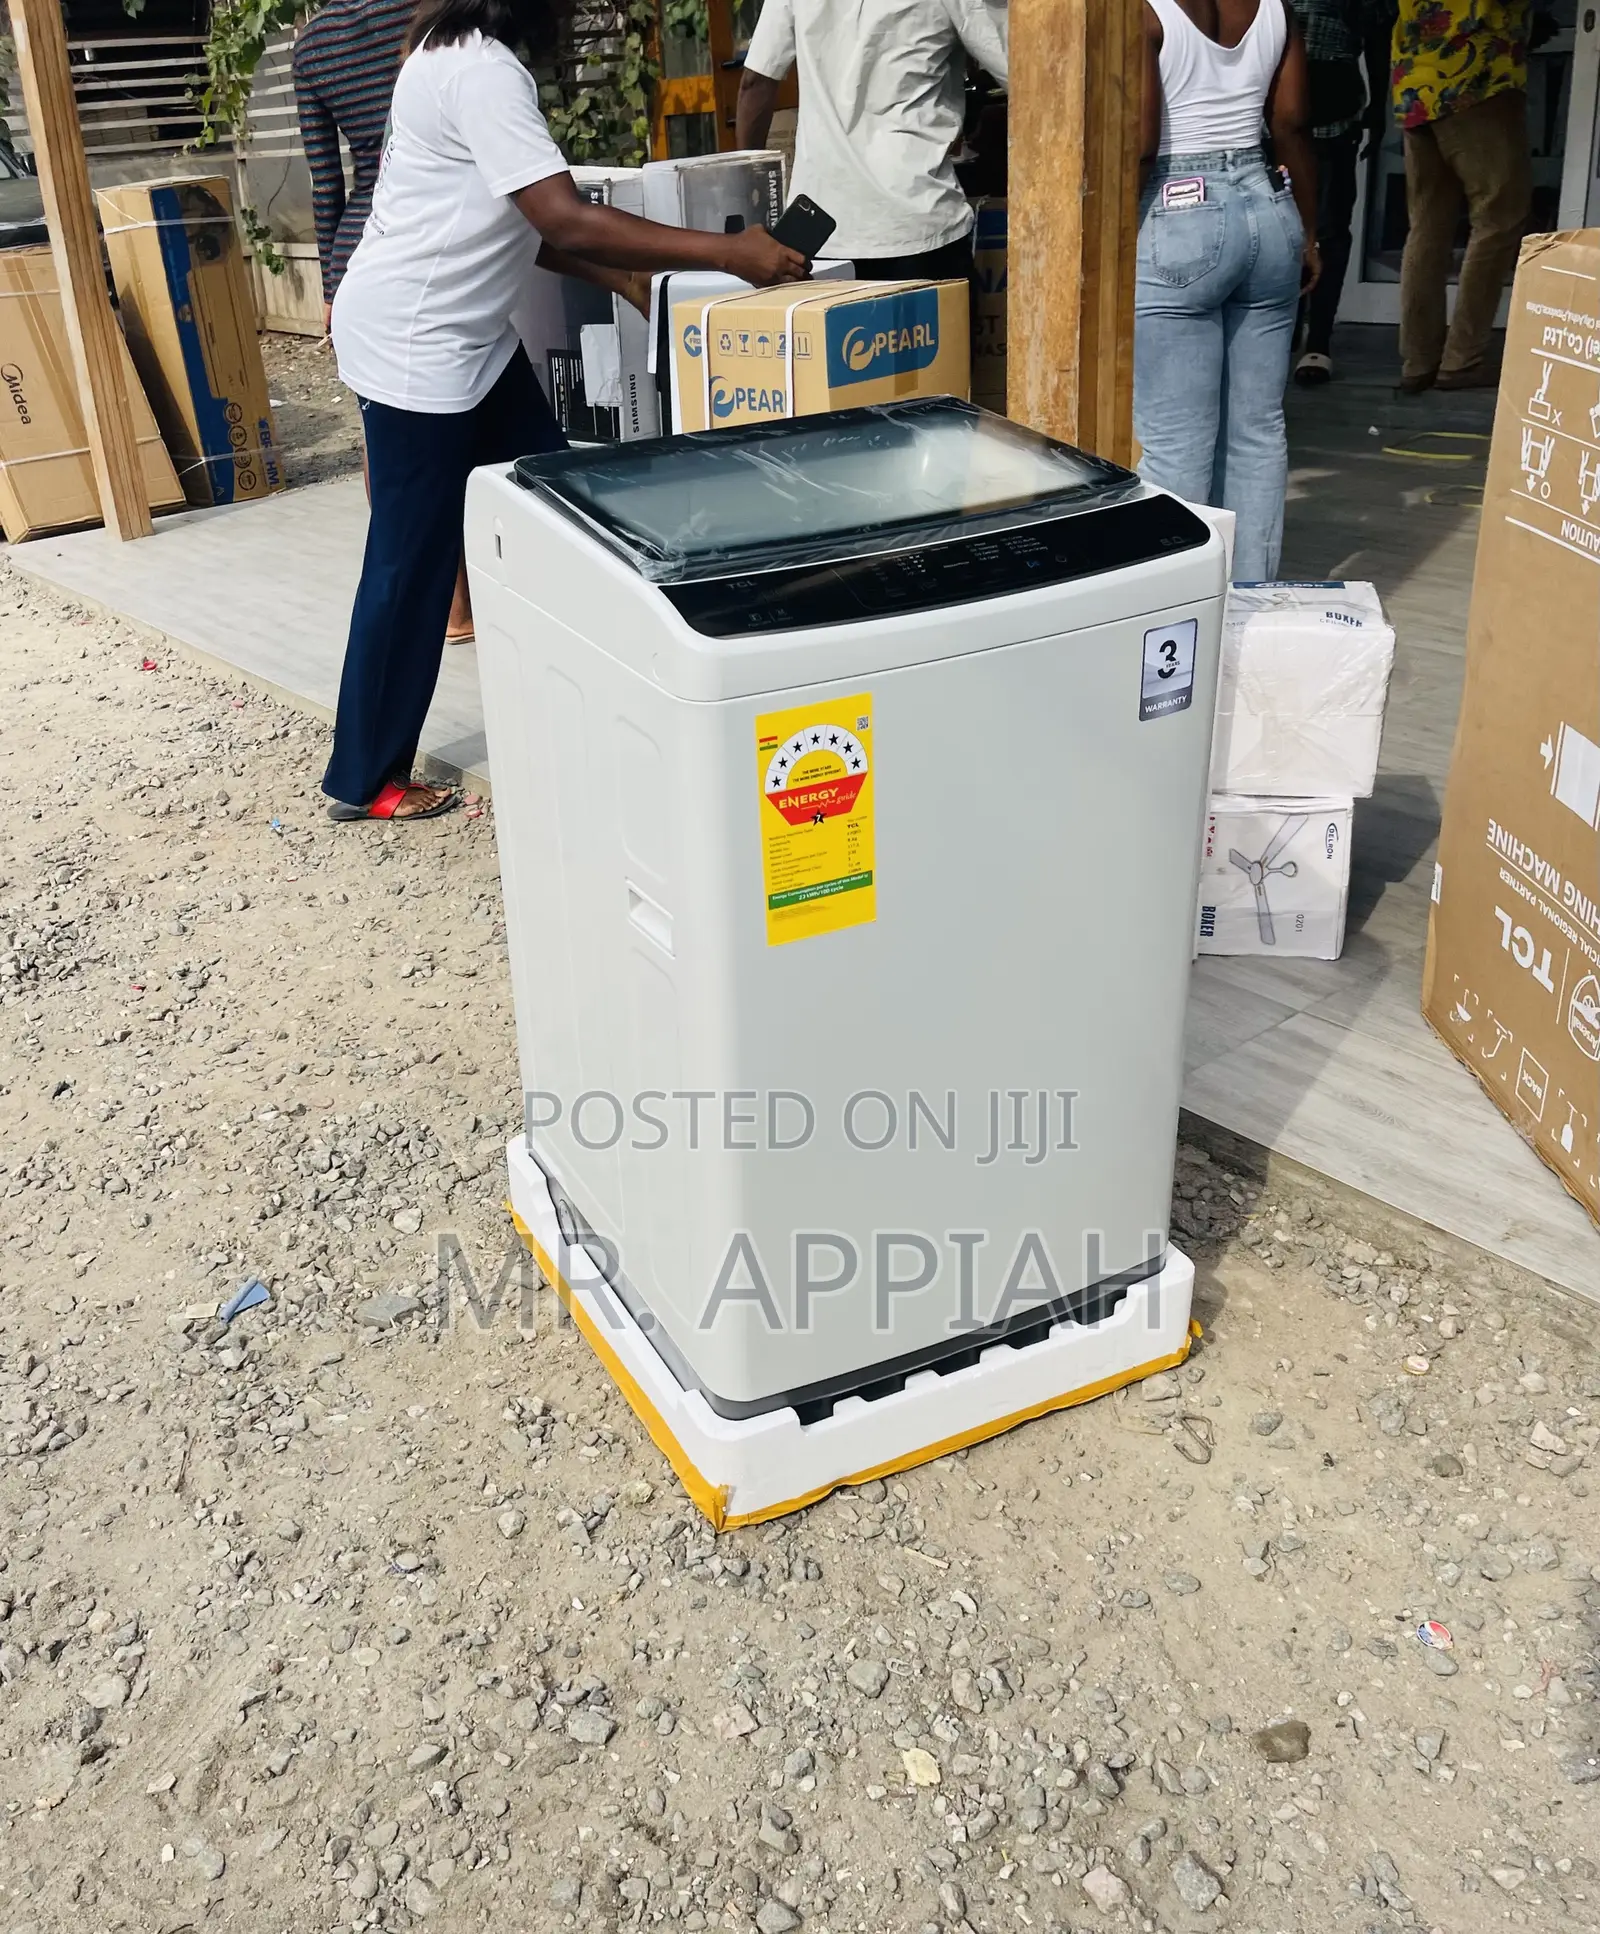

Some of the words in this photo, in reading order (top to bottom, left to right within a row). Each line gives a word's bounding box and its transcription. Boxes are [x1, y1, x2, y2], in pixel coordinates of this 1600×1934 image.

[767, 170, 781, 230] SAMSUN
[873, 320, 936, 358] PEARL
[0, 363, 32, 425] Midea
[629, 373, 640, 434] SAMSUNG
[735, 387, 787, 413] PEAR
[260, 431, 280, 486] BRHM
[1560, 520, 1600, 554] AUTION
[727, 581, 757, 591] TCL
[1157, 639, 1178, 679] 3
[1166, 661, 1181, 669] YEARS
[1145, 695, 1187, 713] WARRANTY
[778, 787, 839, 809] ENERGY
[836, 789, 857, 805] guide
[815, 814, 821, 823] 7
[1326, 827, 1335, 861] DELRON
[1486, 817, 1561, 896] MACHINE
[1499, 866, 1537, 907] PARTNER
[1199, 905, 1217, 938] BOXER
[1295, 913, 1305, 934] 0201
[1537, 898, 1579, 946] REGIONAL
[1562, 879, 1600, 937] HING
[1494, 905, 1555, 994] TCL
[1579, 936, 1600, 970] ICIAL
[1521, 1069, 1543, 1100] BACK
